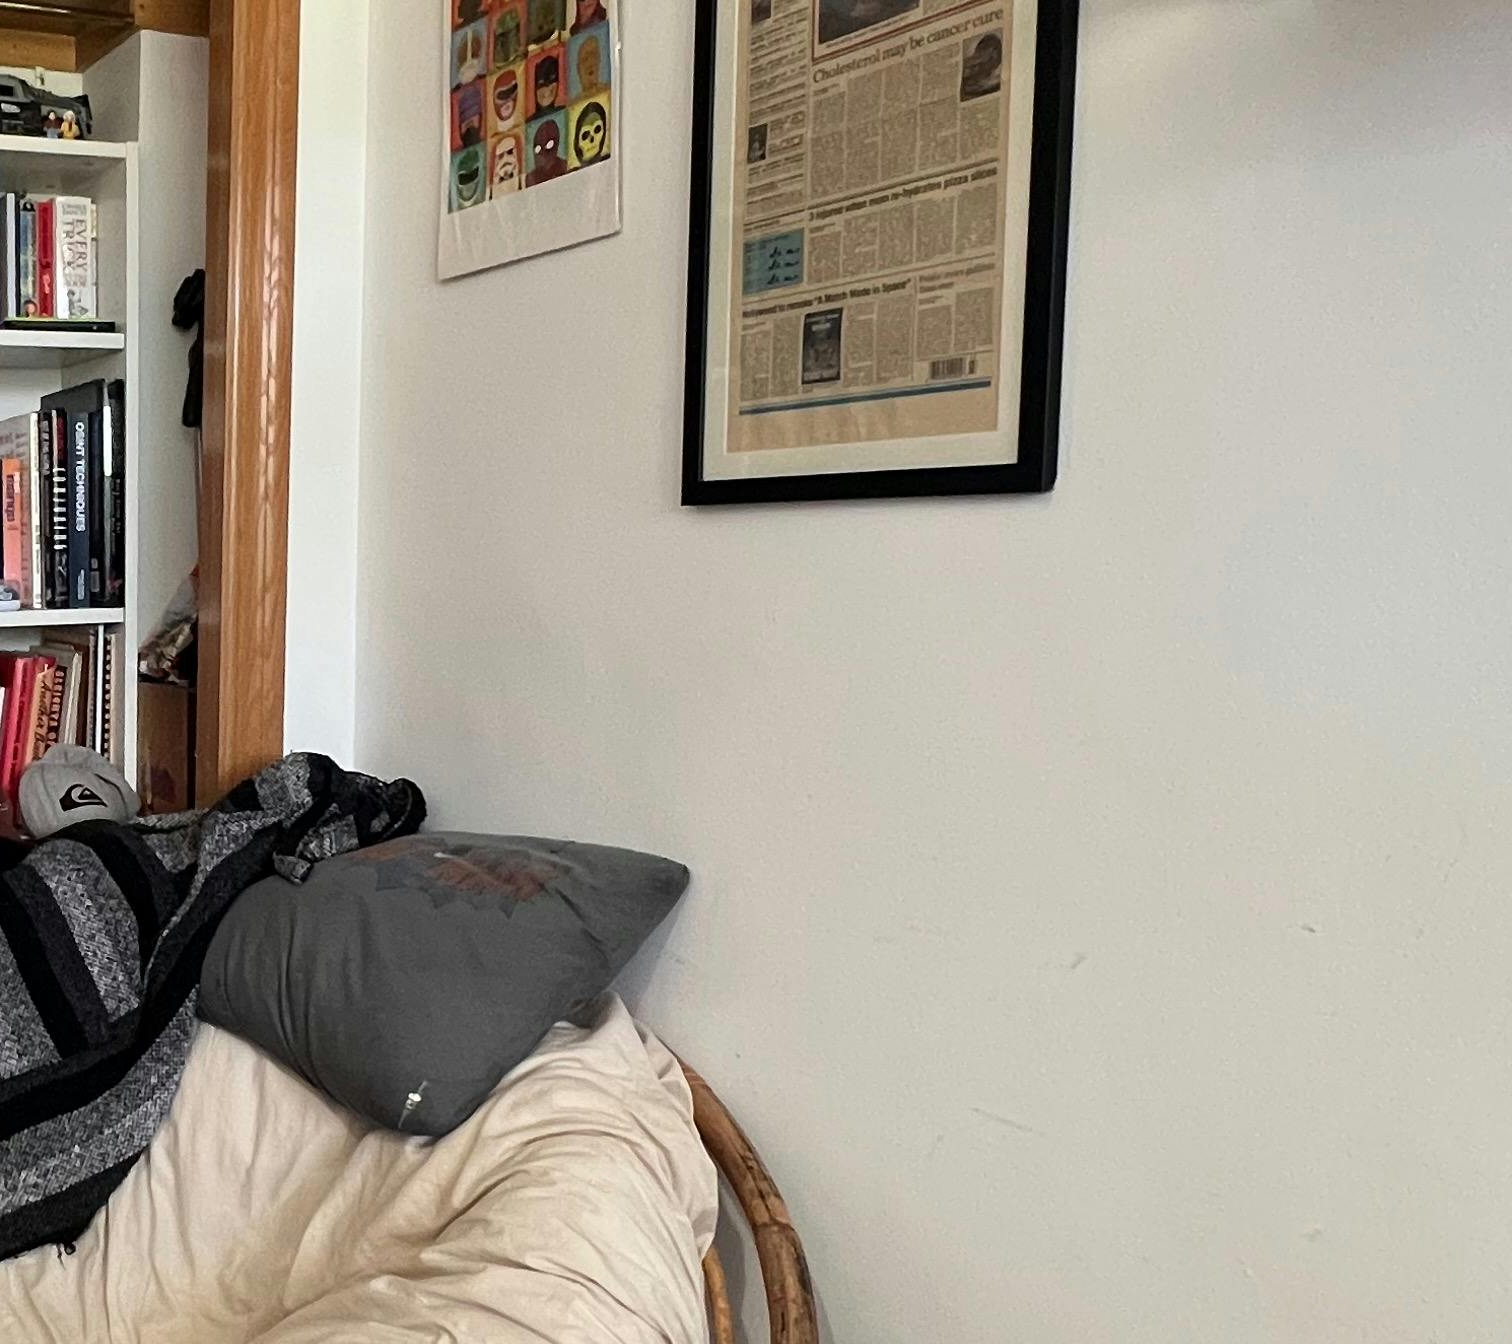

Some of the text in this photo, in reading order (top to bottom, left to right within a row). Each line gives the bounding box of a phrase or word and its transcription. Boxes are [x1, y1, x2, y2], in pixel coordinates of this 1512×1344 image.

[813, 44, 882, 84] Cholesterol
[882, 42, 909, 61] may
[909, 36, 925, 49] be
[926, 21, 970, 44] cancer
[972, 8, 1004, 28] cure
[75, 218, 88, 272] EVERY
[75, 458, 86, 532] TECHNIQUES
